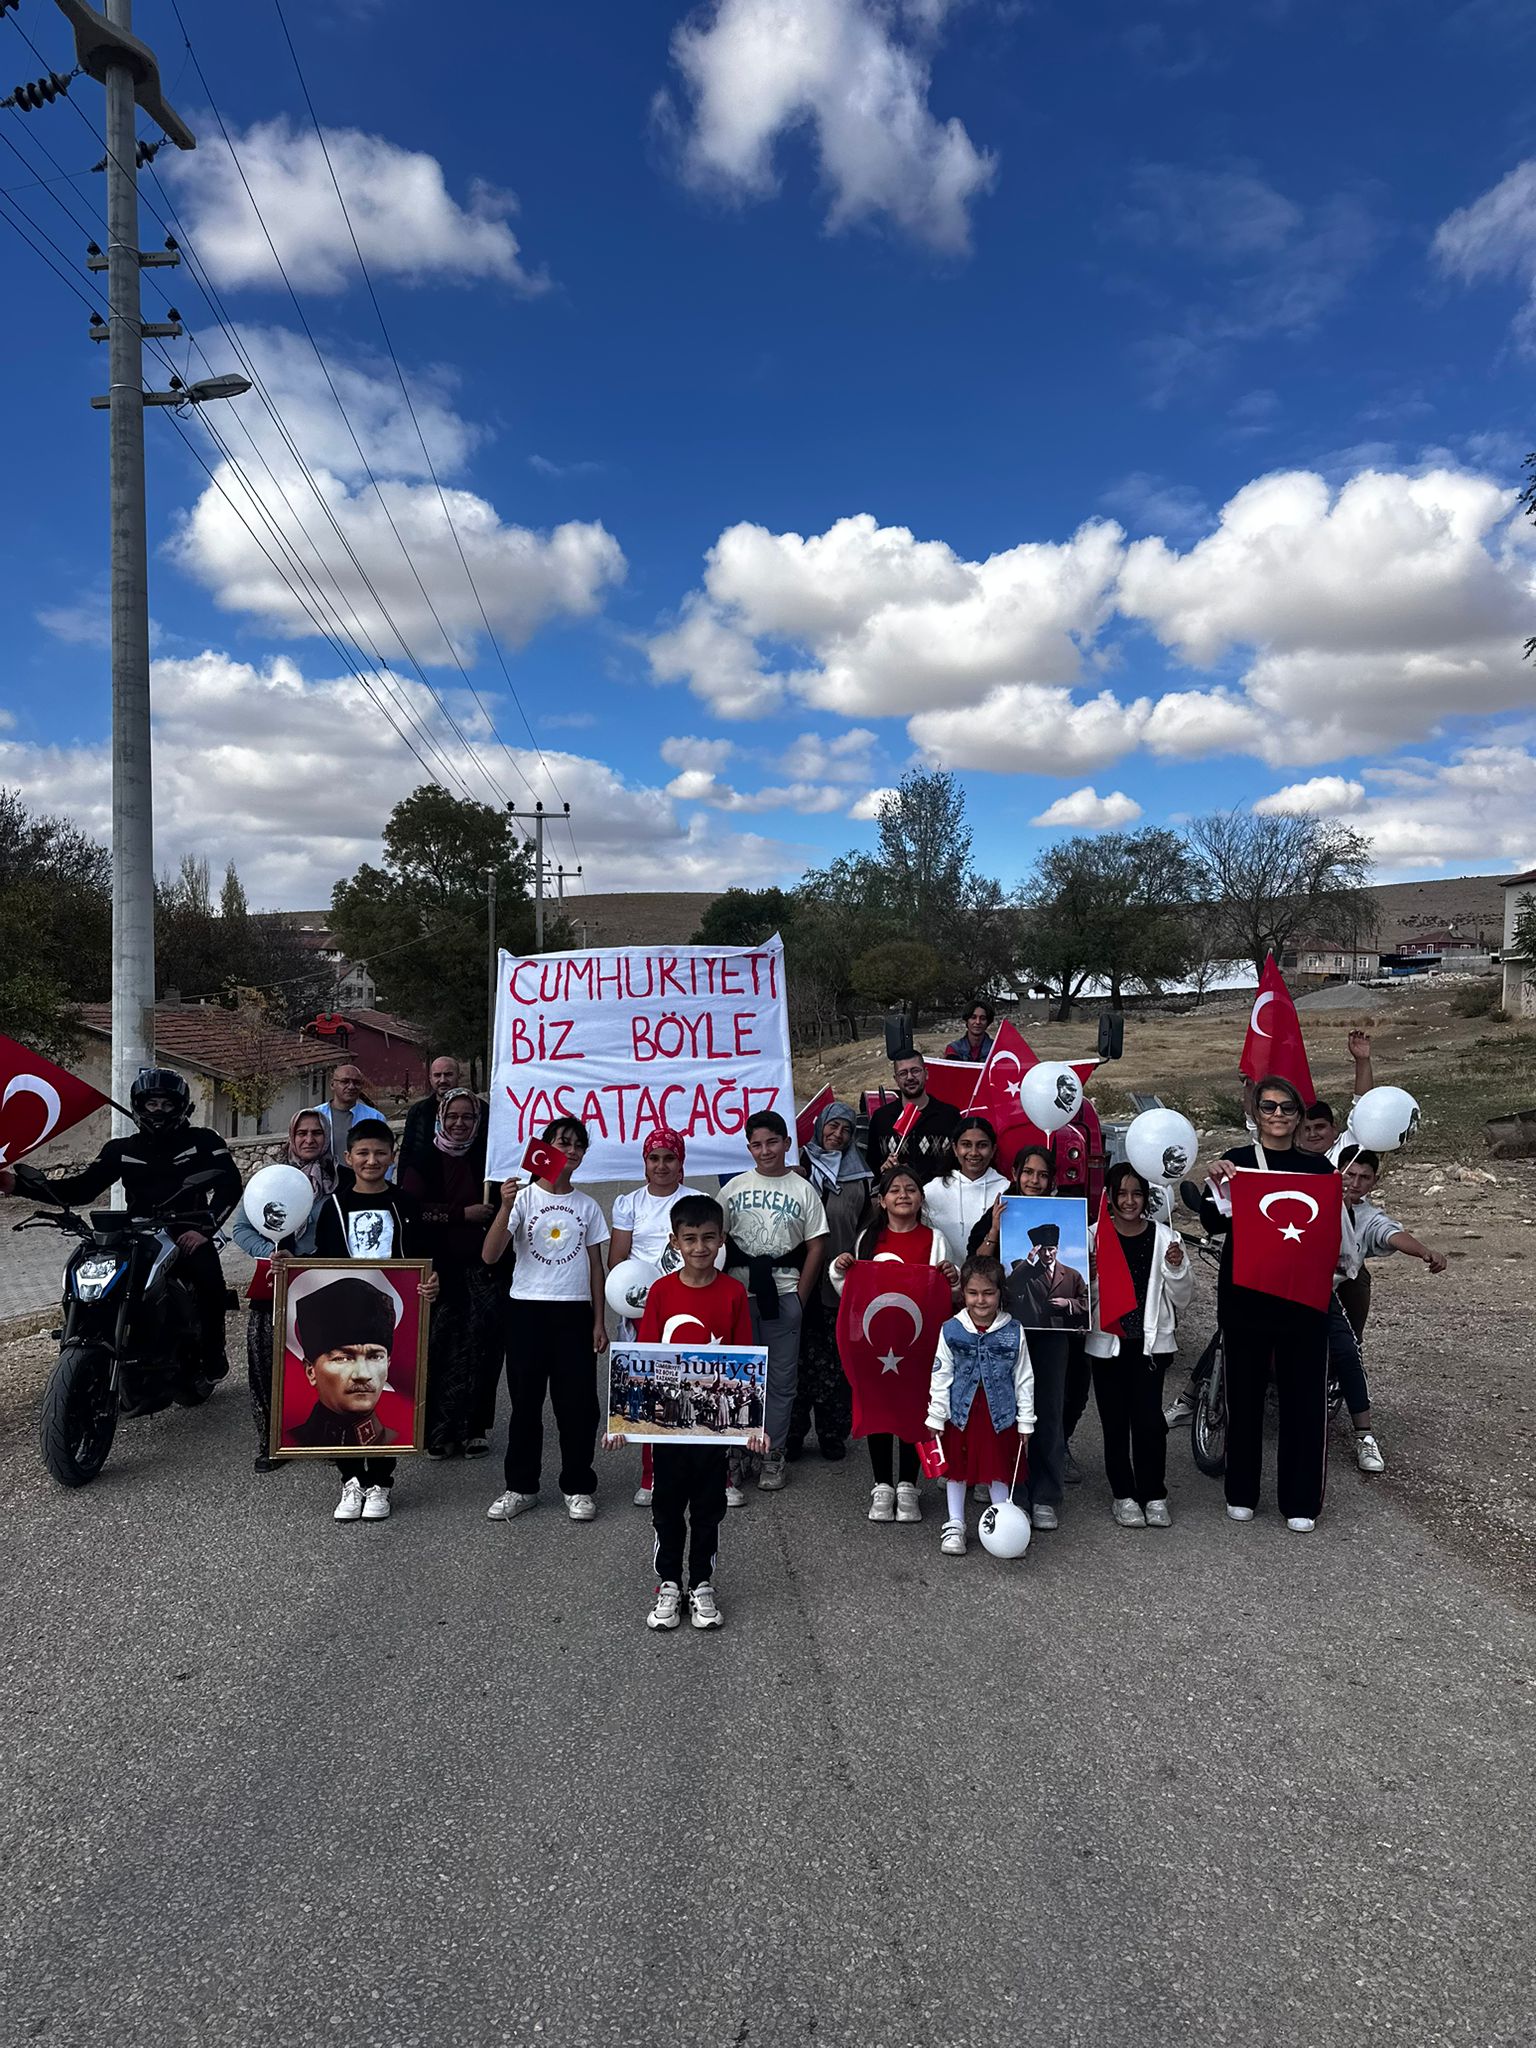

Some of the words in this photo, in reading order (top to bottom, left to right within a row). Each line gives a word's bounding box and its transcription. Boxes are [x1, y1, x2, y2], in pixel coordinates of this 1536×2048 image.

[512, 1014, 585, 1065] BİZ
[632, 1011, 761, 1062] BÖYLE
[540, 1205, 574, 1215] BONJOUR
[728, 1190, 801, 1219] WEEKEND
[530, 1249, 552, 1266] DAISY
